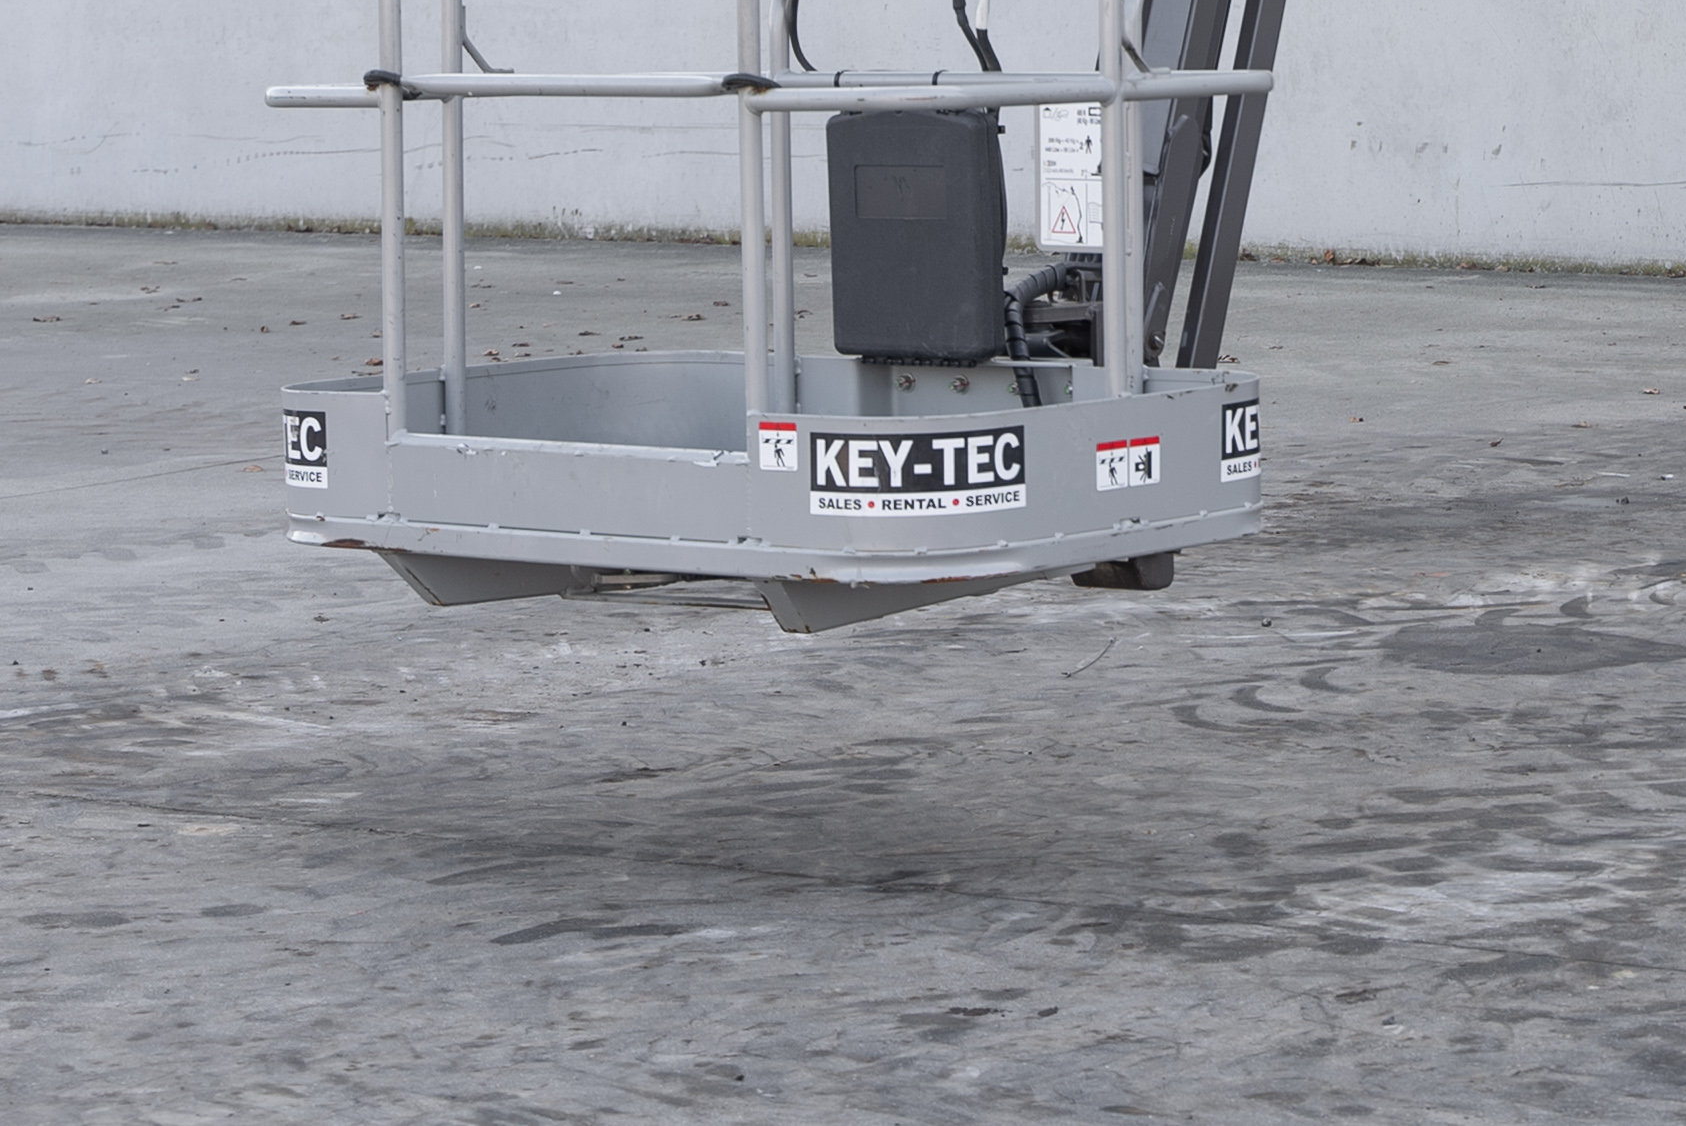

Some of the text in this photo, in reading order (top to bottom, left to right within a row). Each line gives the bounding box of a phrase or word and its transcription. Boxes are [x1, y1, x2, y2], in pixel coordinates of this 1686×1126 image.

[1225, 404, 1260, 454] KE
[816, 432, 1021, 488] KEY-TEC
[1226, 460, 1252, 476] SALES
[288, 469, 323, 483] SERVICE
[818, 490, 1020, 511] SALES RENTAL SERVICE
